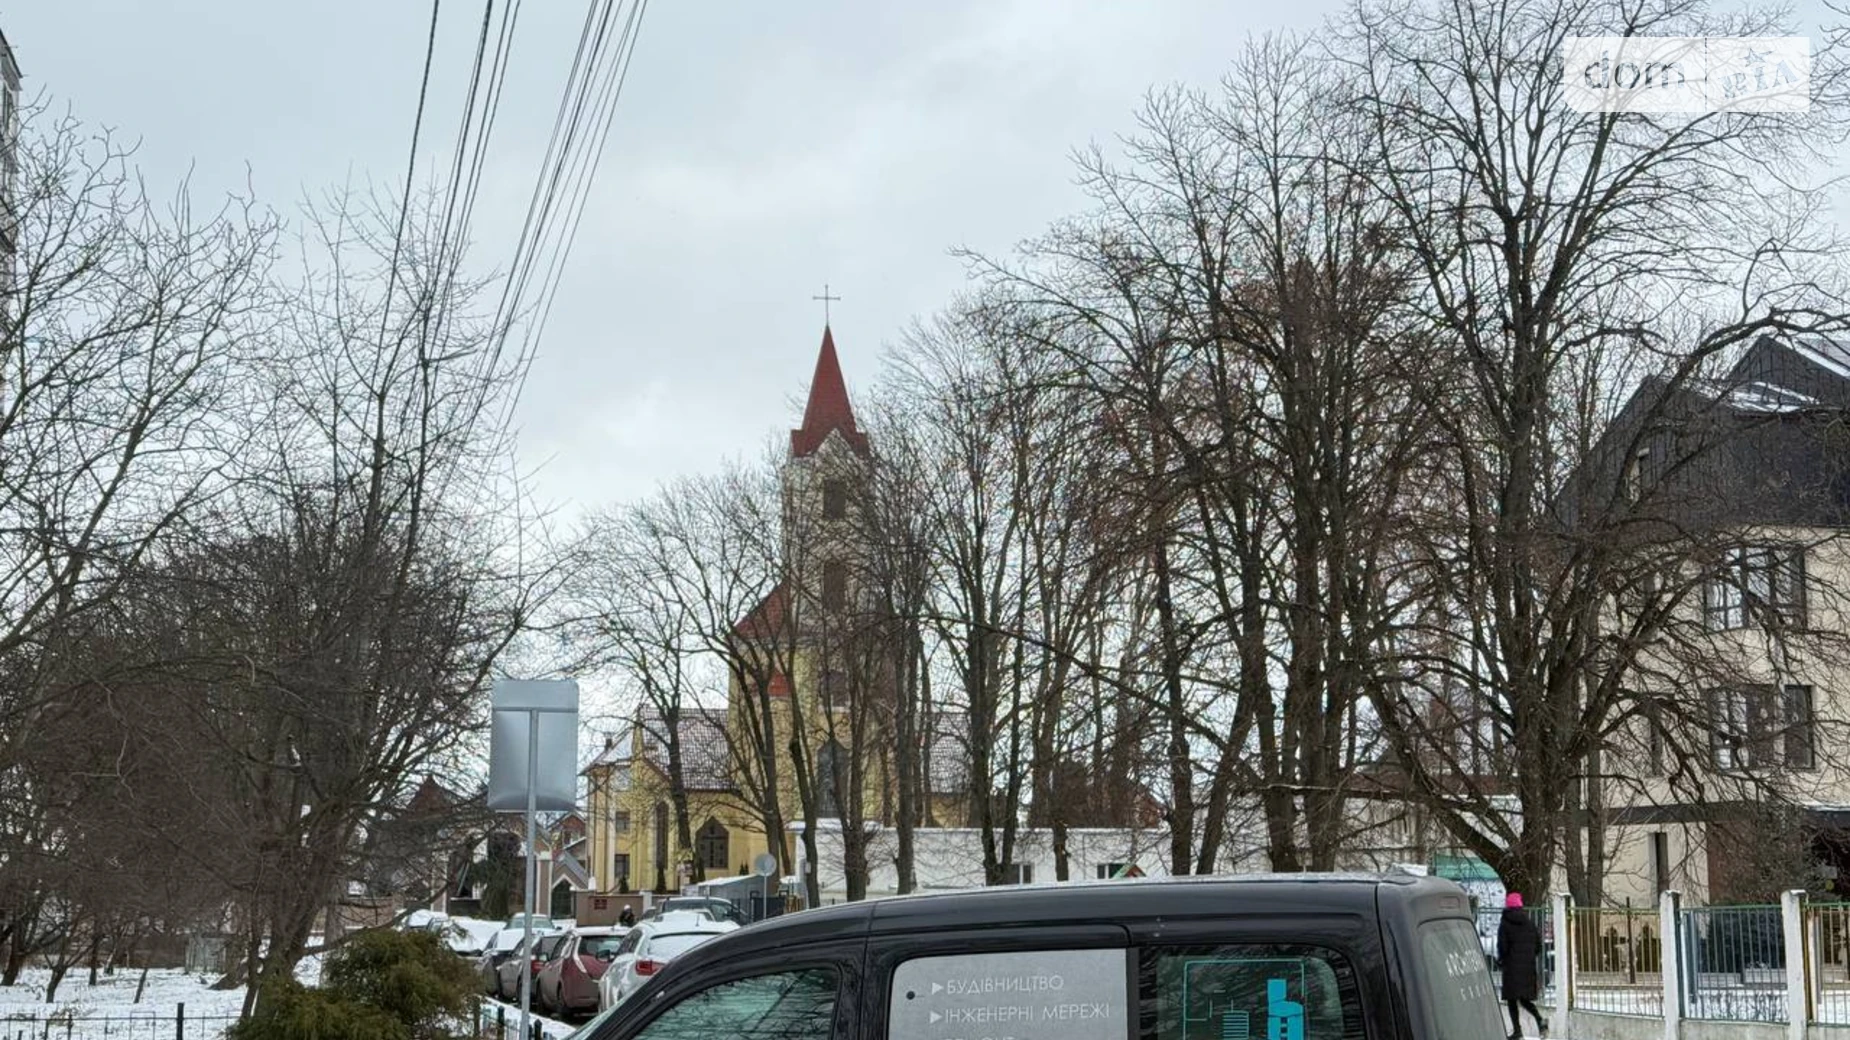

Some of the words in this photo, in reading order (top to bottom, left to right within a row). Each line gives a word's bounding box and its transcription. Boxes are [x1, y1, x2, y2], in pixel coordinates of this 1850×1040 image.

[946, 975, 1065, 996] БУДІВНИЦТВО
[944, 1005, 1034, 1024] ІНЖЕНЕРНІ
[1042, 1003, 1110, 1021] МЕРЕЖІ
